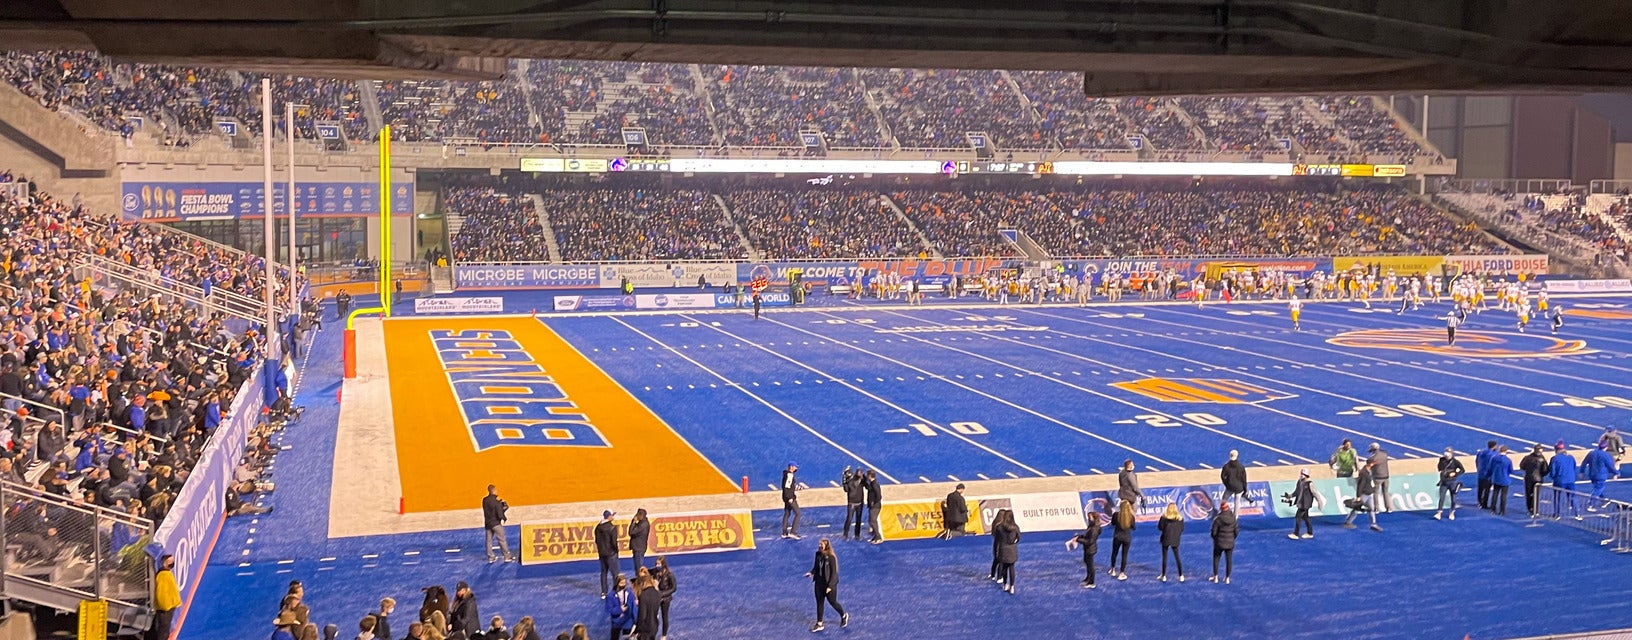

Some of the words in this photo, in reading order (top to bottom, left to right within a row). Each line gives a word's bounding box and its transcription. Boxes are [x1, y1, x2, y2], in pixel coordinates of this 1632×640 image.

[181, 195, 207, 204] FIESTA
[208, 194, 234, 204] BOWL
[181, 204, 229, 215] CHAMPIONS
[1104, 262, 1132, 272] JOIN
[1134, 262, 1158, 271] THE
[459, 268, 525, 281] MICROBE
[533, 268, 597, 280] MICROBE
[428, 329, 614, 453] BRONCOS
[1134, 412, 1228, 427] 20
[909, 421, 990, 437] 10
[1147, 494, 1172, 505] BANK
[1023, 509, 1045, 519] BUILT
[1045, 508, 1060, 517] FOR
[1060, 507, 1079, 516] YOU.
[654, 520, 707, 532] GROWN
[710, 519, 727, 530] IN
[655, 527, 737, 549] IDAHO
